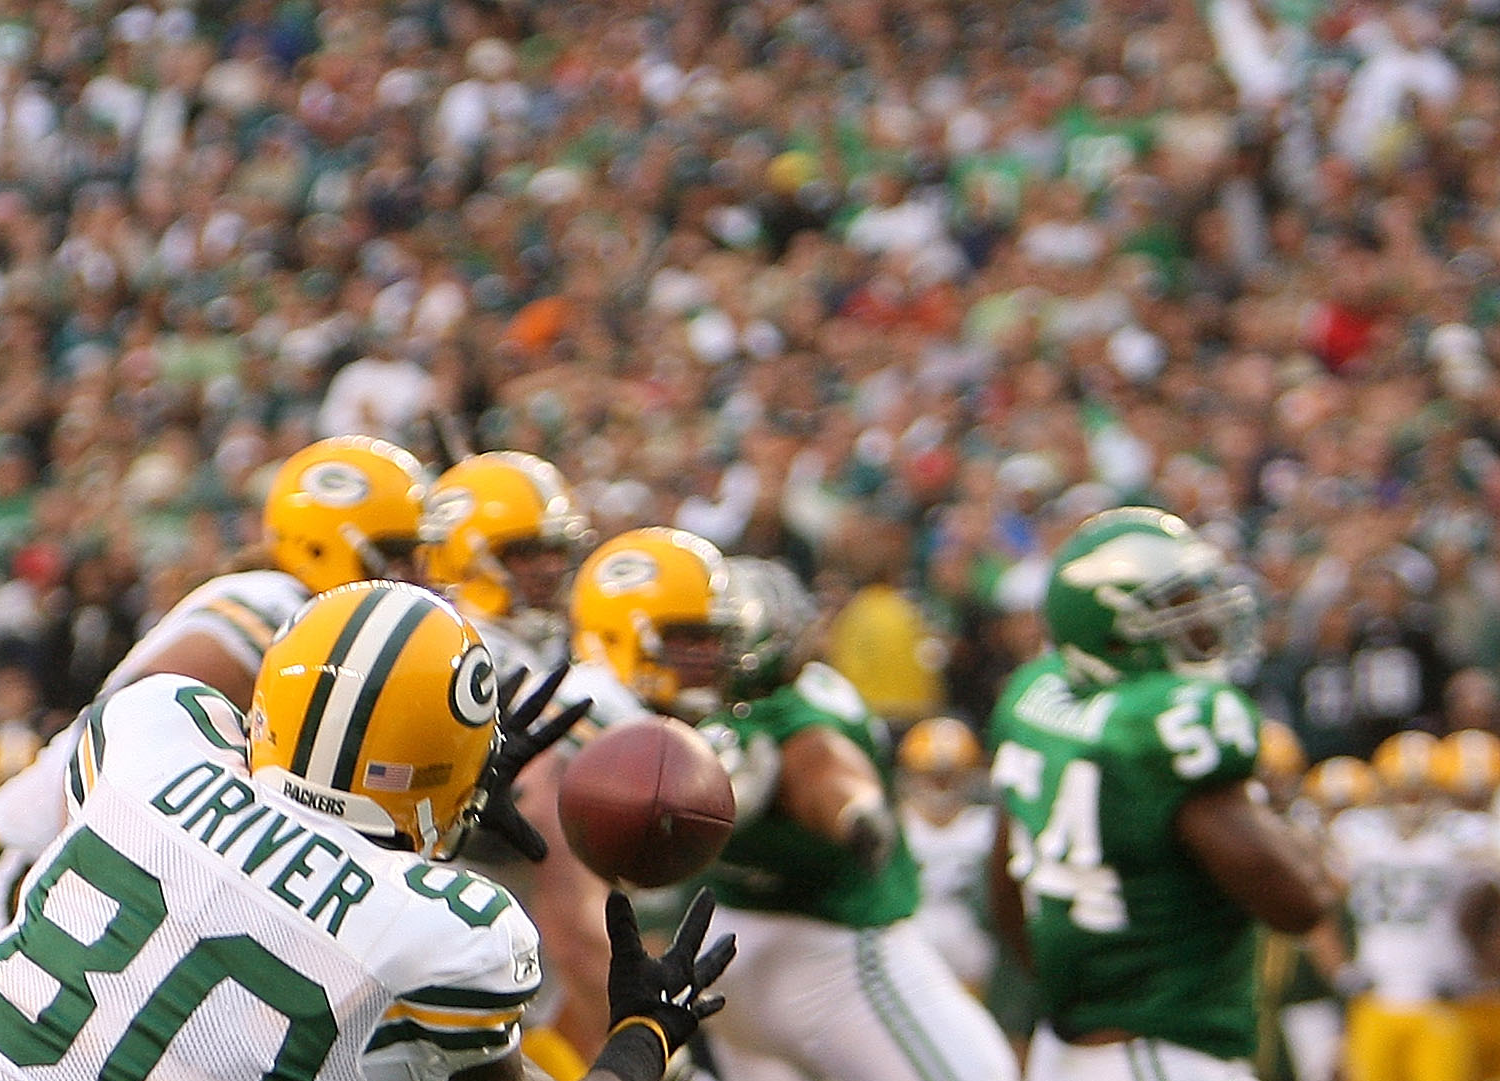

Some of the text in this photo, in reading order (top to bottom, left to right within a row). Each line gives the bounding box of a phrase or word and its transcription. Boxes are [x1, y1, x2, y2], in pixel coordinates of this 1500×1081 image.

[1155, 681, 1257, 780] 54
[282, 780, 347, 817] PACKERS
[151, 760, 375, 938] DRIVER
